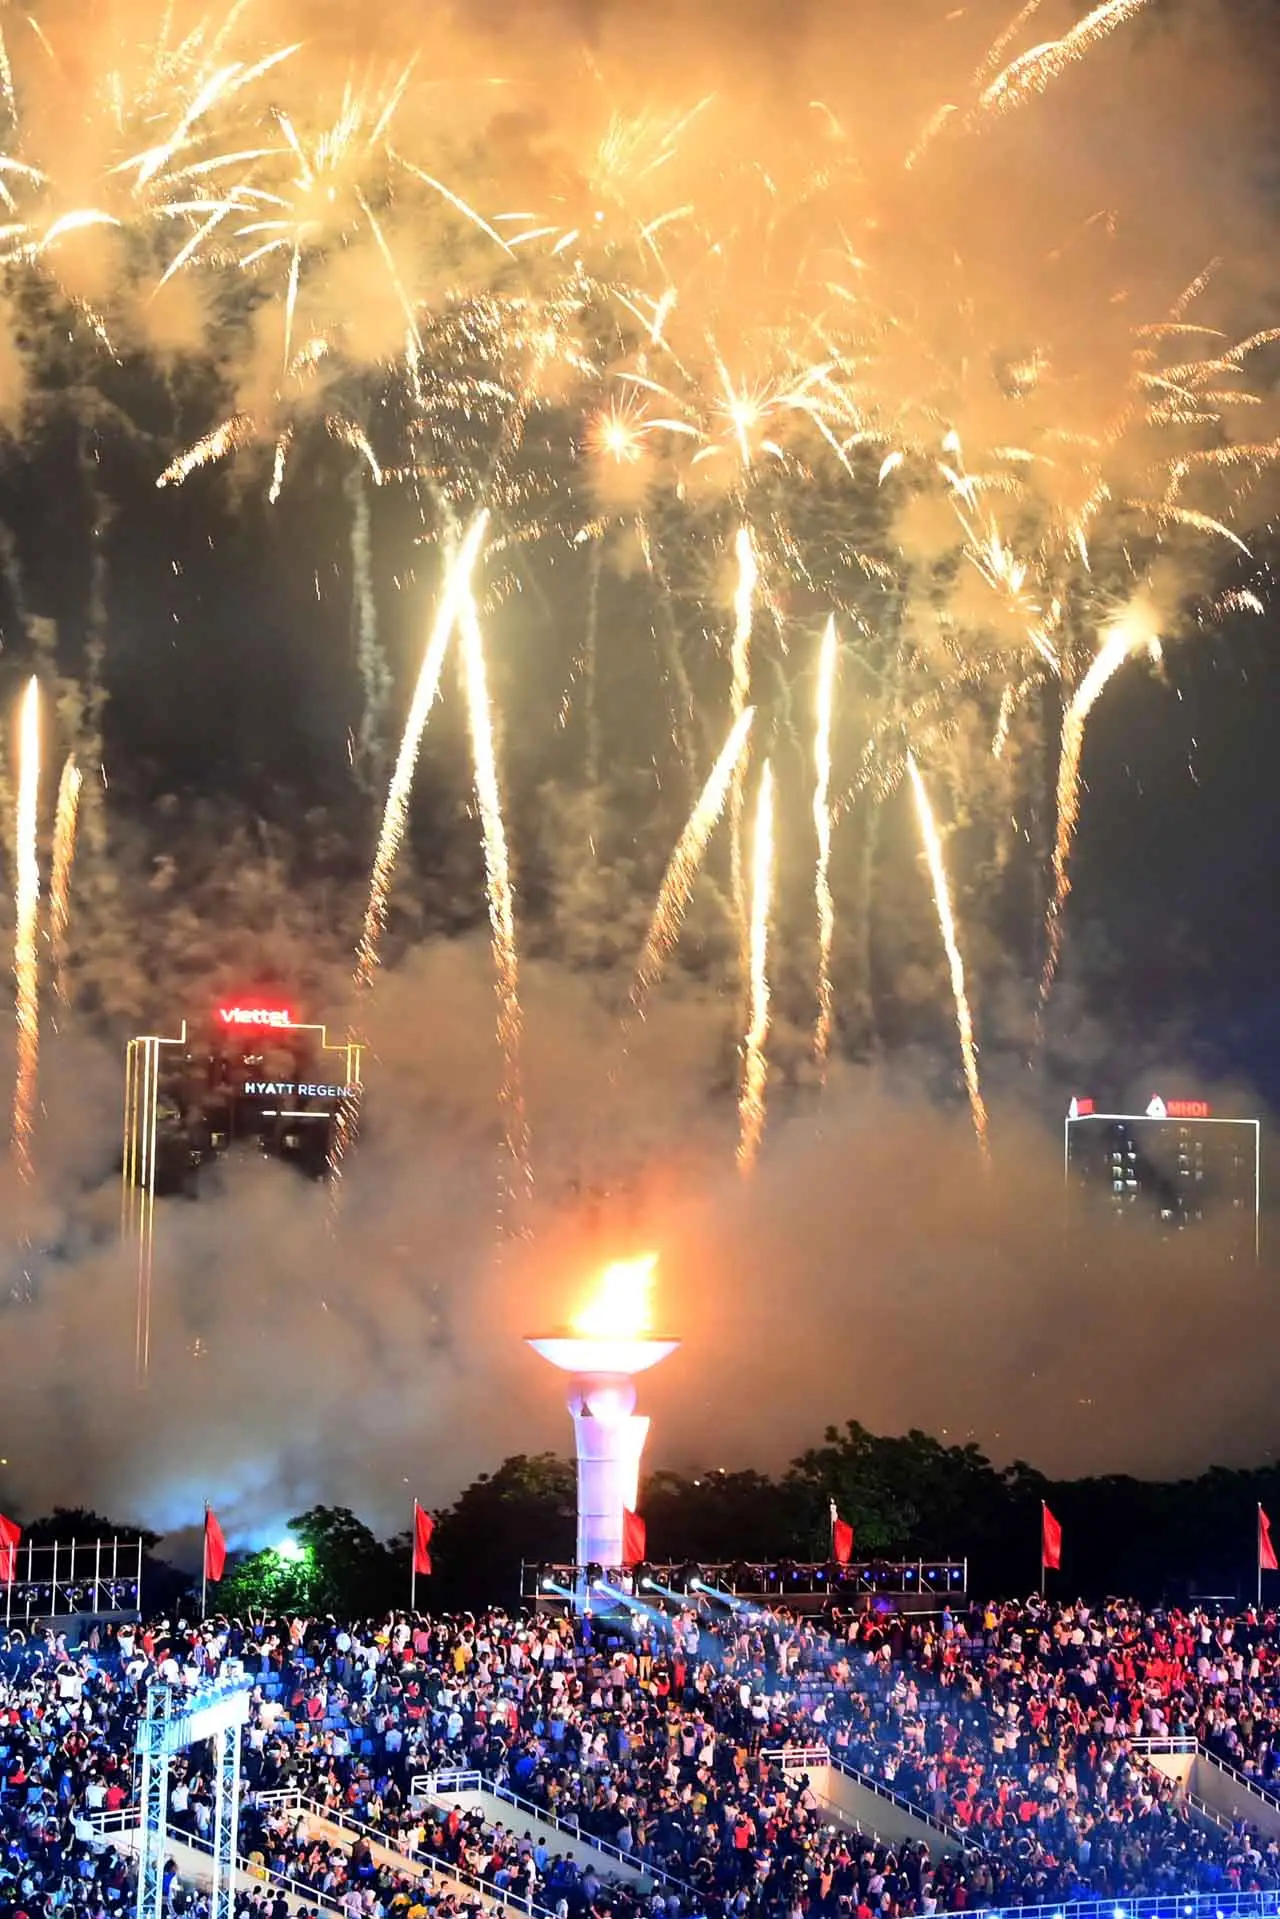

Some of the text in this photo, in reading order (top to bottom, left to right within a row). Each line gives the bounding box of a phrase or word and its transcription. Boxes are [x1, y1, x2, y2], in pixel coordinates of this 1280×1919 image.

[244, 1082, 361, 1097] HYATT REGENC
[1167, 1101, 1208, 1117] MHDI
